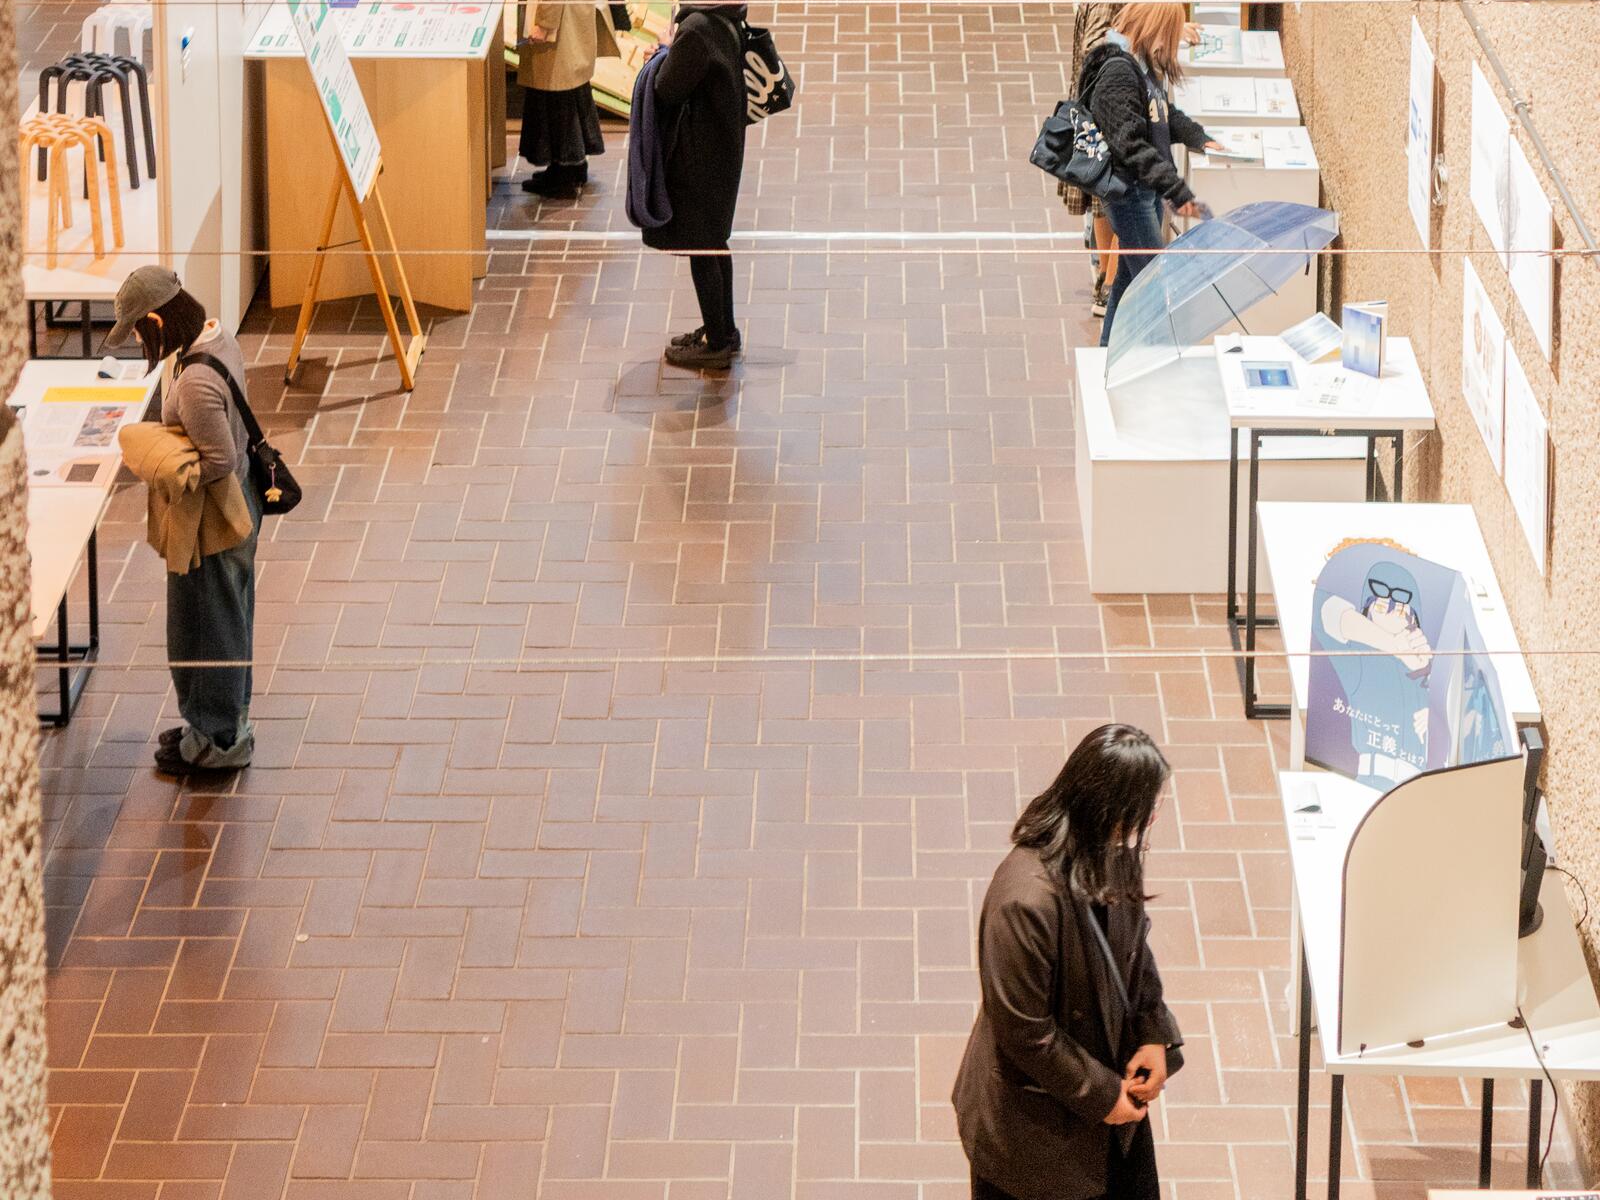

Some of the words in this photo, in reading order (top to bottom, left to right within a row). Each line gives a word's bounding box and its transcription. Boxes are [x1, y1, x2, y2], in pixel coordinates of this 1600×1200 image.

[1332, 697, 1400, 735] あなたにとって
